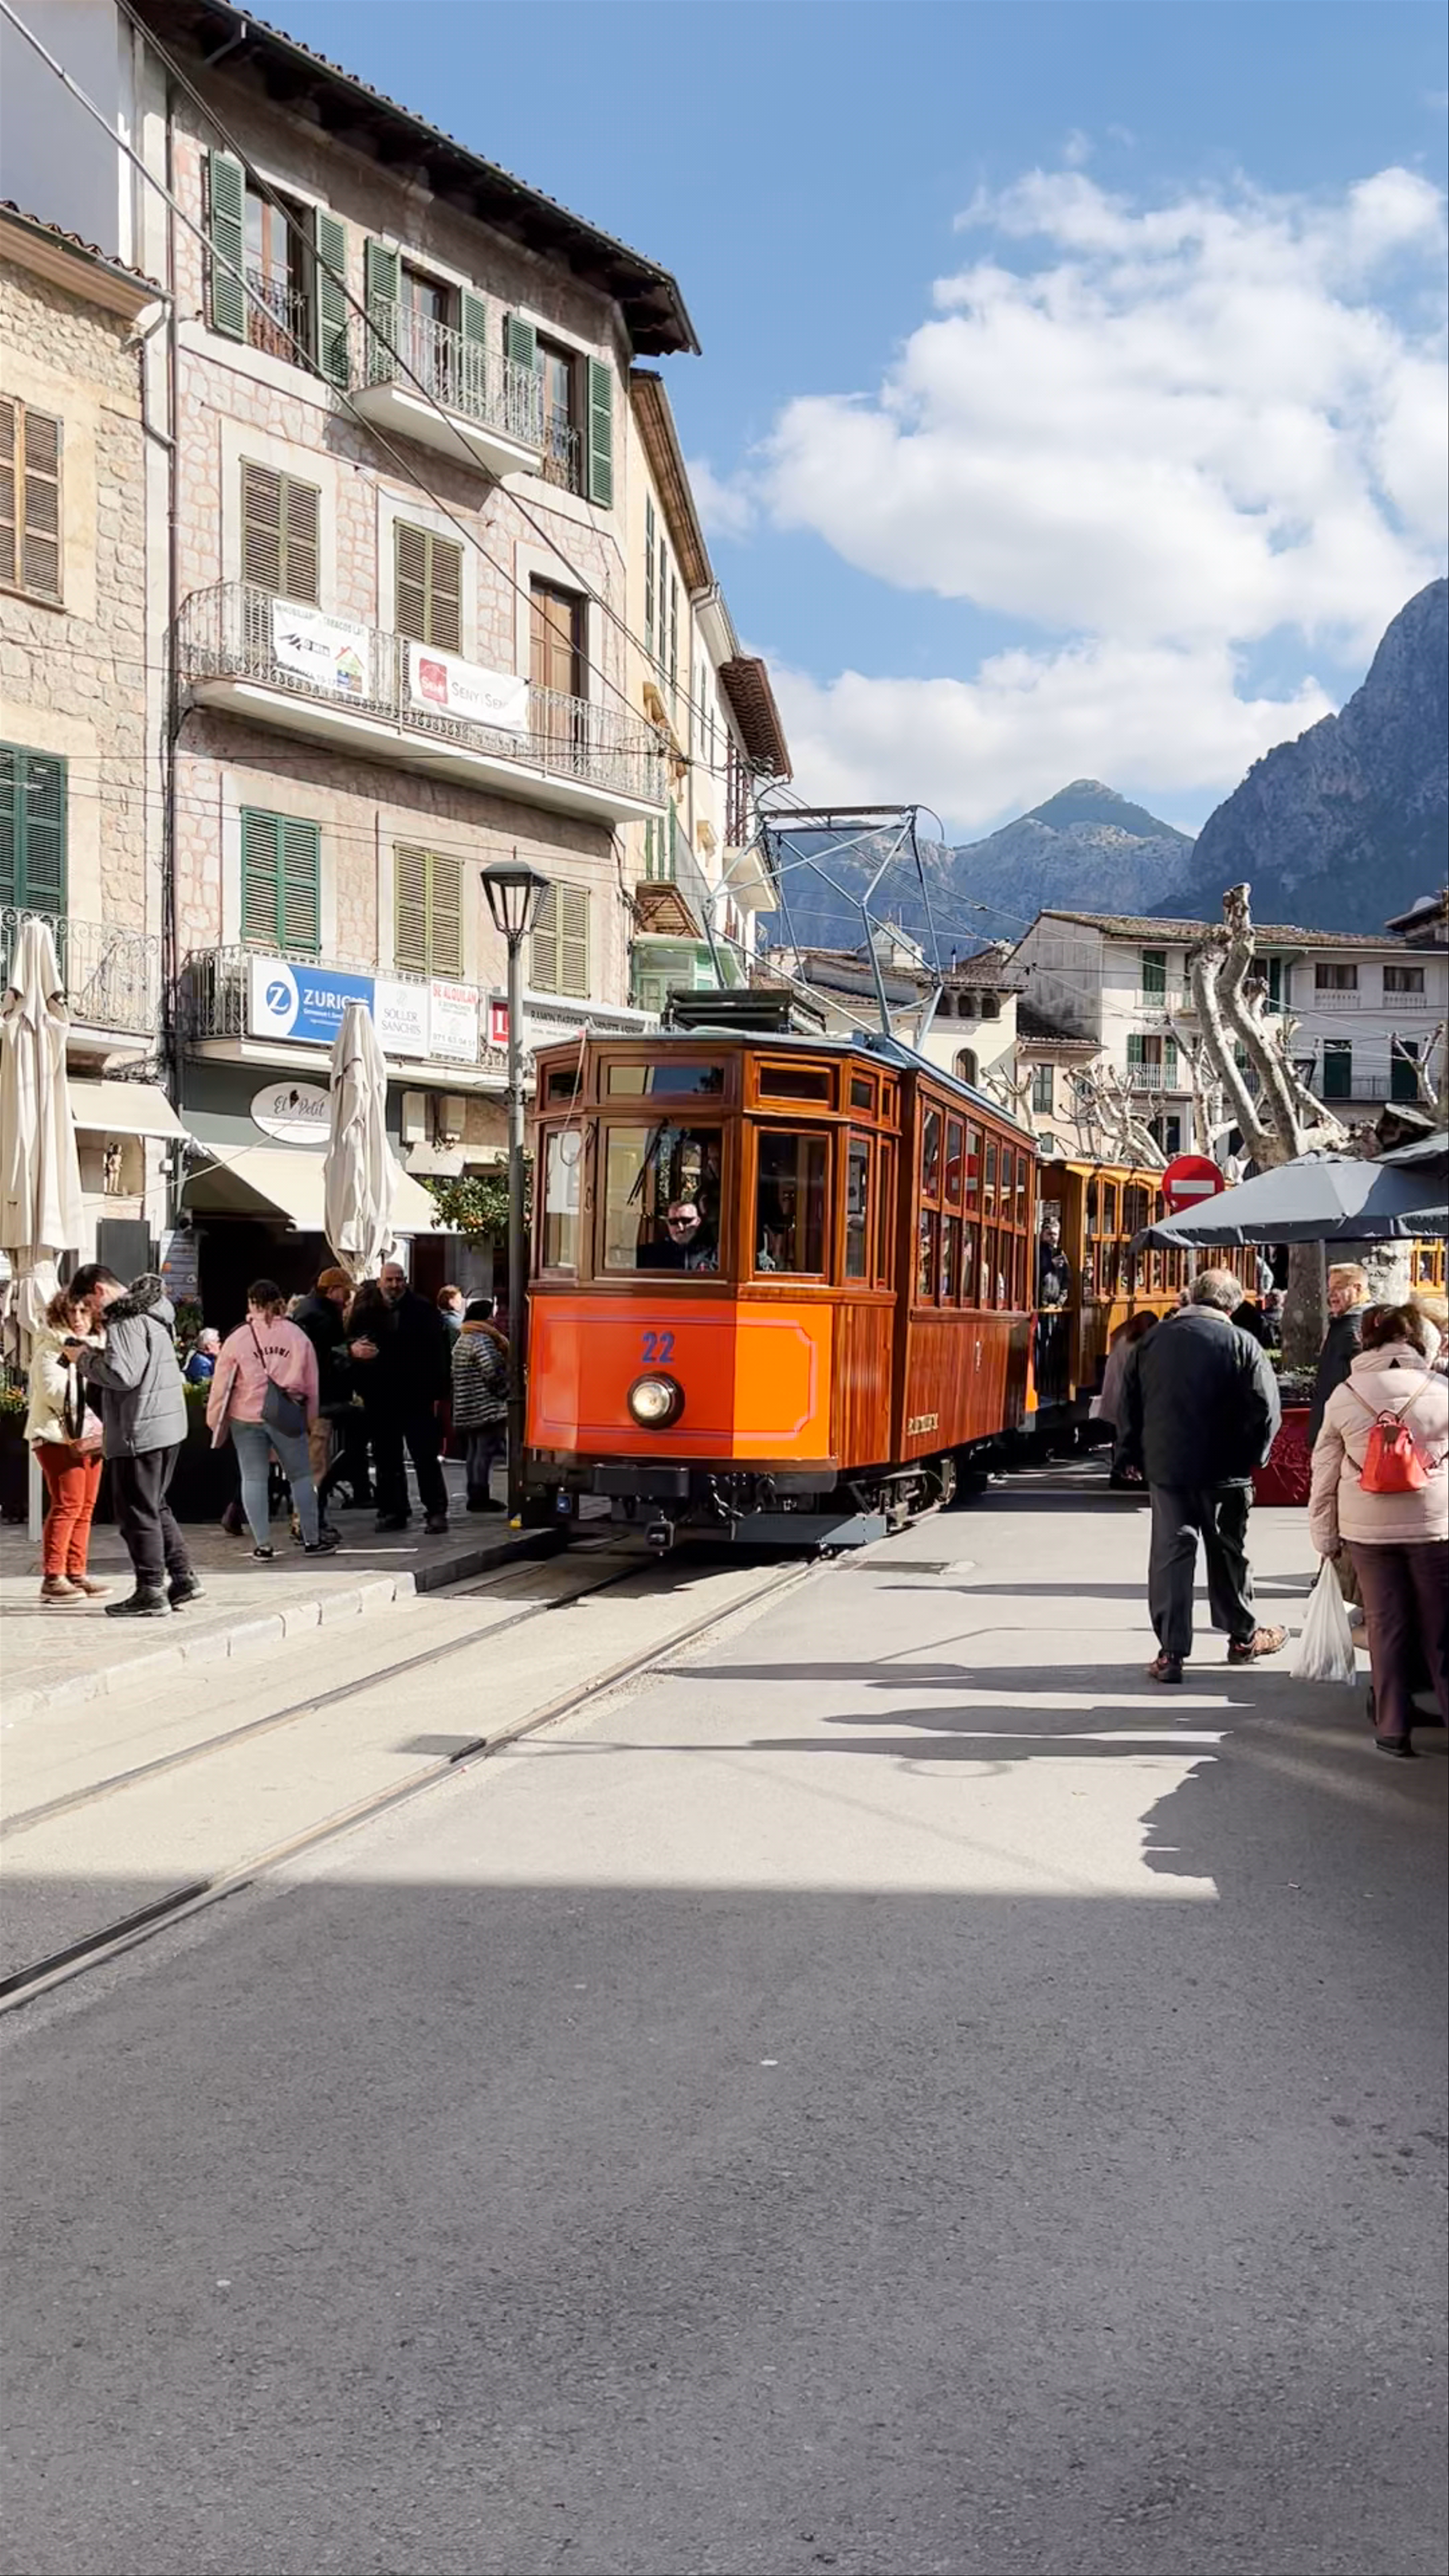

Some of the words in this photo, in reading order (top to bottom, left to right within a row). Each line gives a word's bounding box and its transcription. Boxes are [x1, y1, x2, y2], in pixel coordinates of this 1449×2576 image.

[303, 989, 363, 1009] ZURIC
[274, 1095, 287, 1114] El
[643, 1331, 674, 1363] 22
